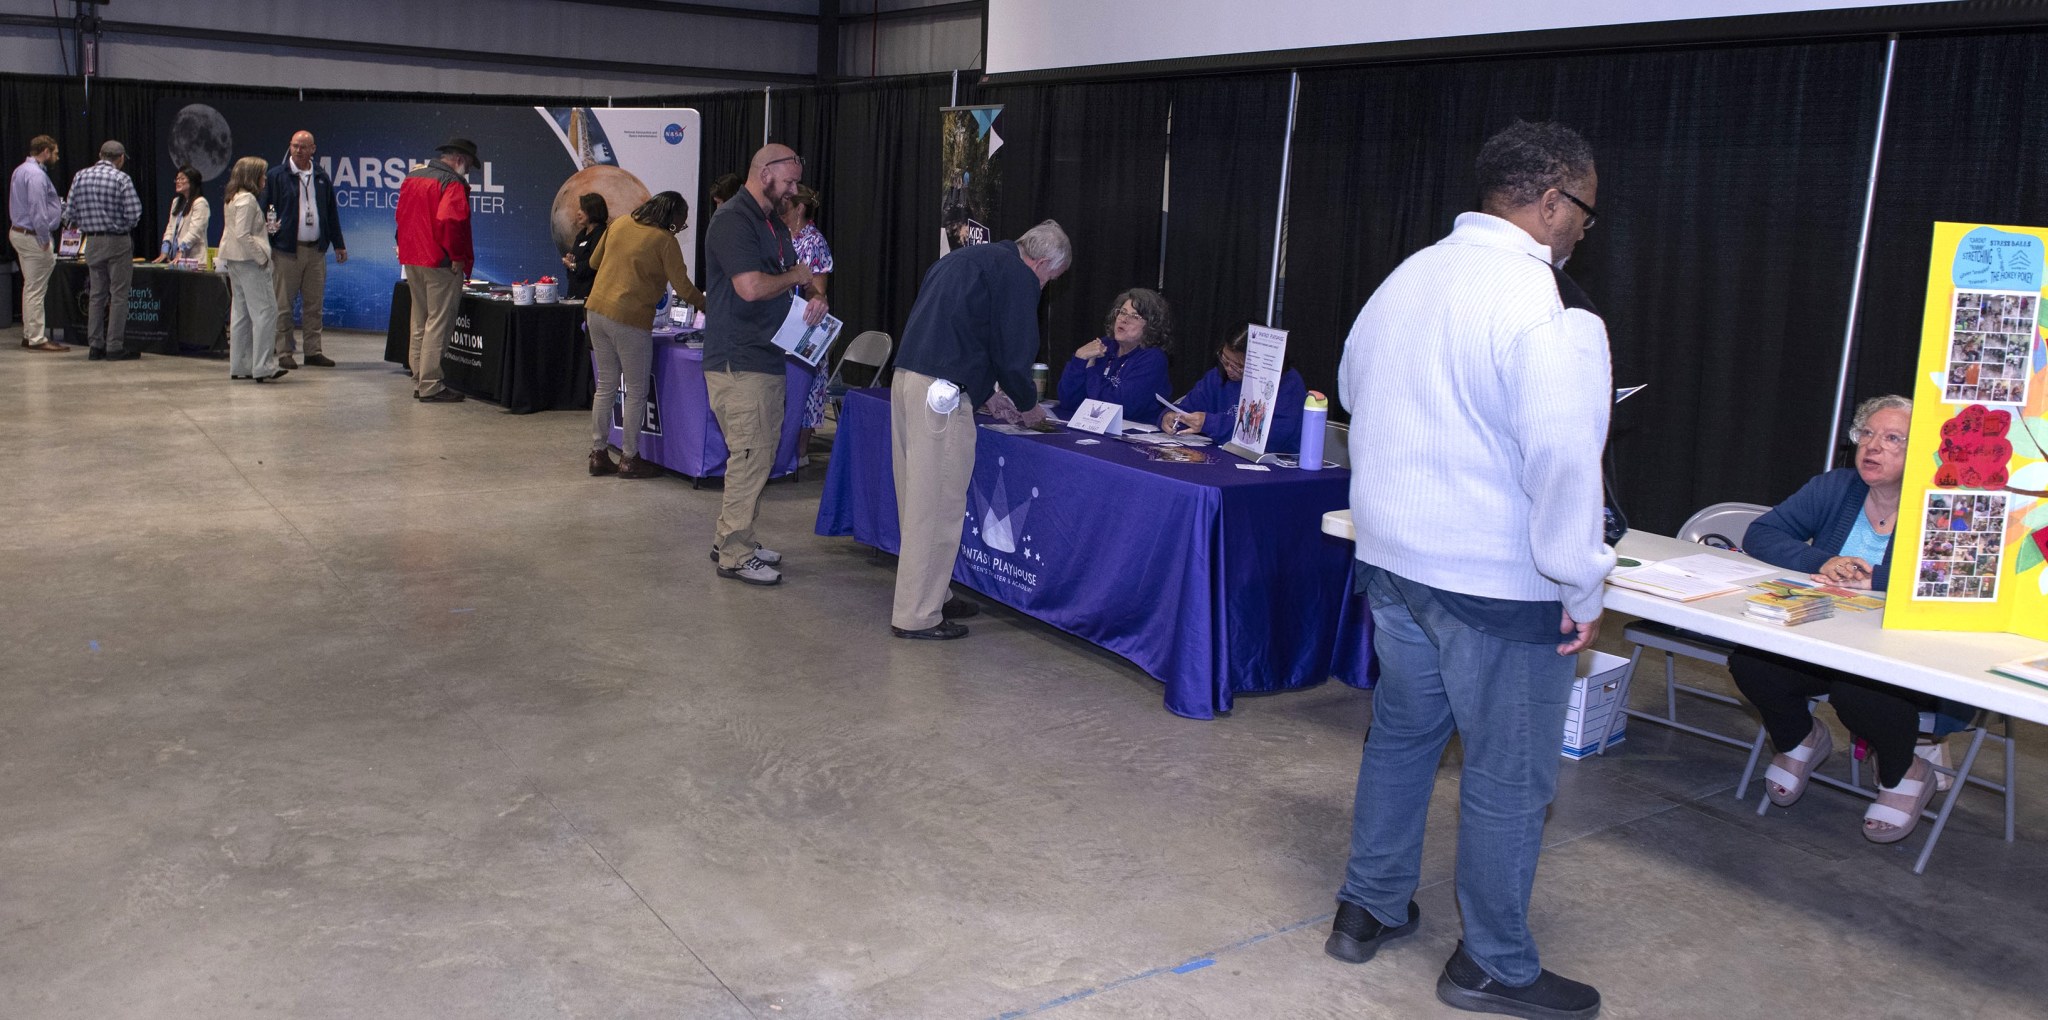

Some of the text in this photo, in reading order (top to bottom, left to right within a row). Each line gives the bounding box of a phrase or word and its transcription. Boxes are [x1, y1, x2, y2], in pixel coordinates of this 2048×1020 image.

[1991, 271, 2033, 284] THE HOKEY POKEY
[128, 287, 152, 299] dren's
[127, 298, 161, 311] niofacial
[127, 310, 159, 322] ociation
[451, 331, 482, 349] DATION
[992, 557, 1037, 586] PLAYHOUSE
